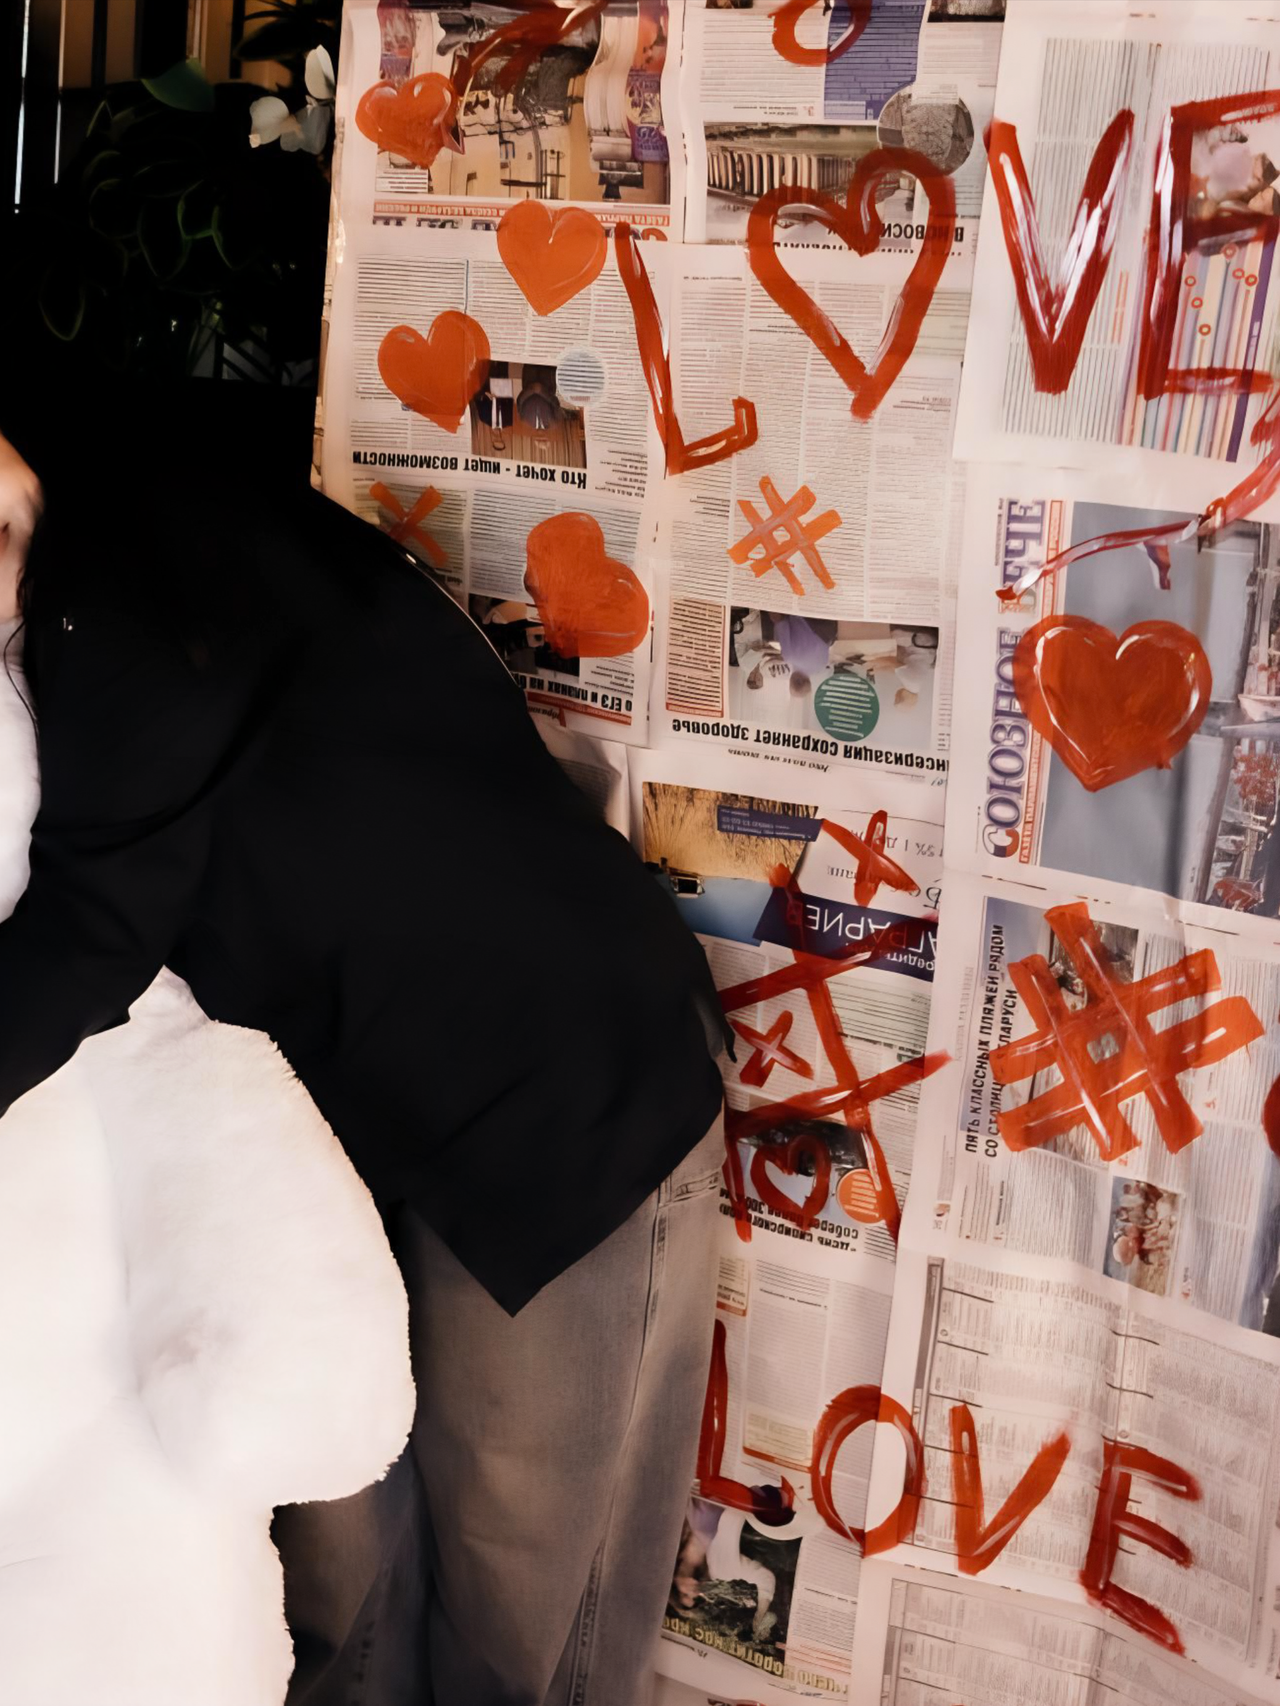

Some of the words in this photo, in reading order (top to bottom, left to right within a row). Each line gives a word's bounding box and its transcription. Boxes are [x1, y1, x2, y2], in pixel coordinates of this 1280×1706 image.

[353, 451, 458, 470] возможности
[463, 458, 500, 475] ищет
[516, 465, 555, 482] хочет
[562, 472, 587, 489] Кто
[548, 681, 588, 701] планах
[591, 692, 598, 703] и
[601, 695, 621, 711] ЕГЭ
[625, 700, 632, 711] о
[672, 719, 749, 741] здоровье
[754, 729, 838, 756] сохраняет
[988, 925, 1004, 971] РЯДОМ
[979, 975, 999, 1035] ПЛЯЖЕЙ
[970, 1040, 990, 1114] КЛАССНЫХ
[965, 1119, 980, 1153] ПЯТЬ
[985, 1140, 997, 1157] СО
[697, 1319, 1204, 1656] LOVE
